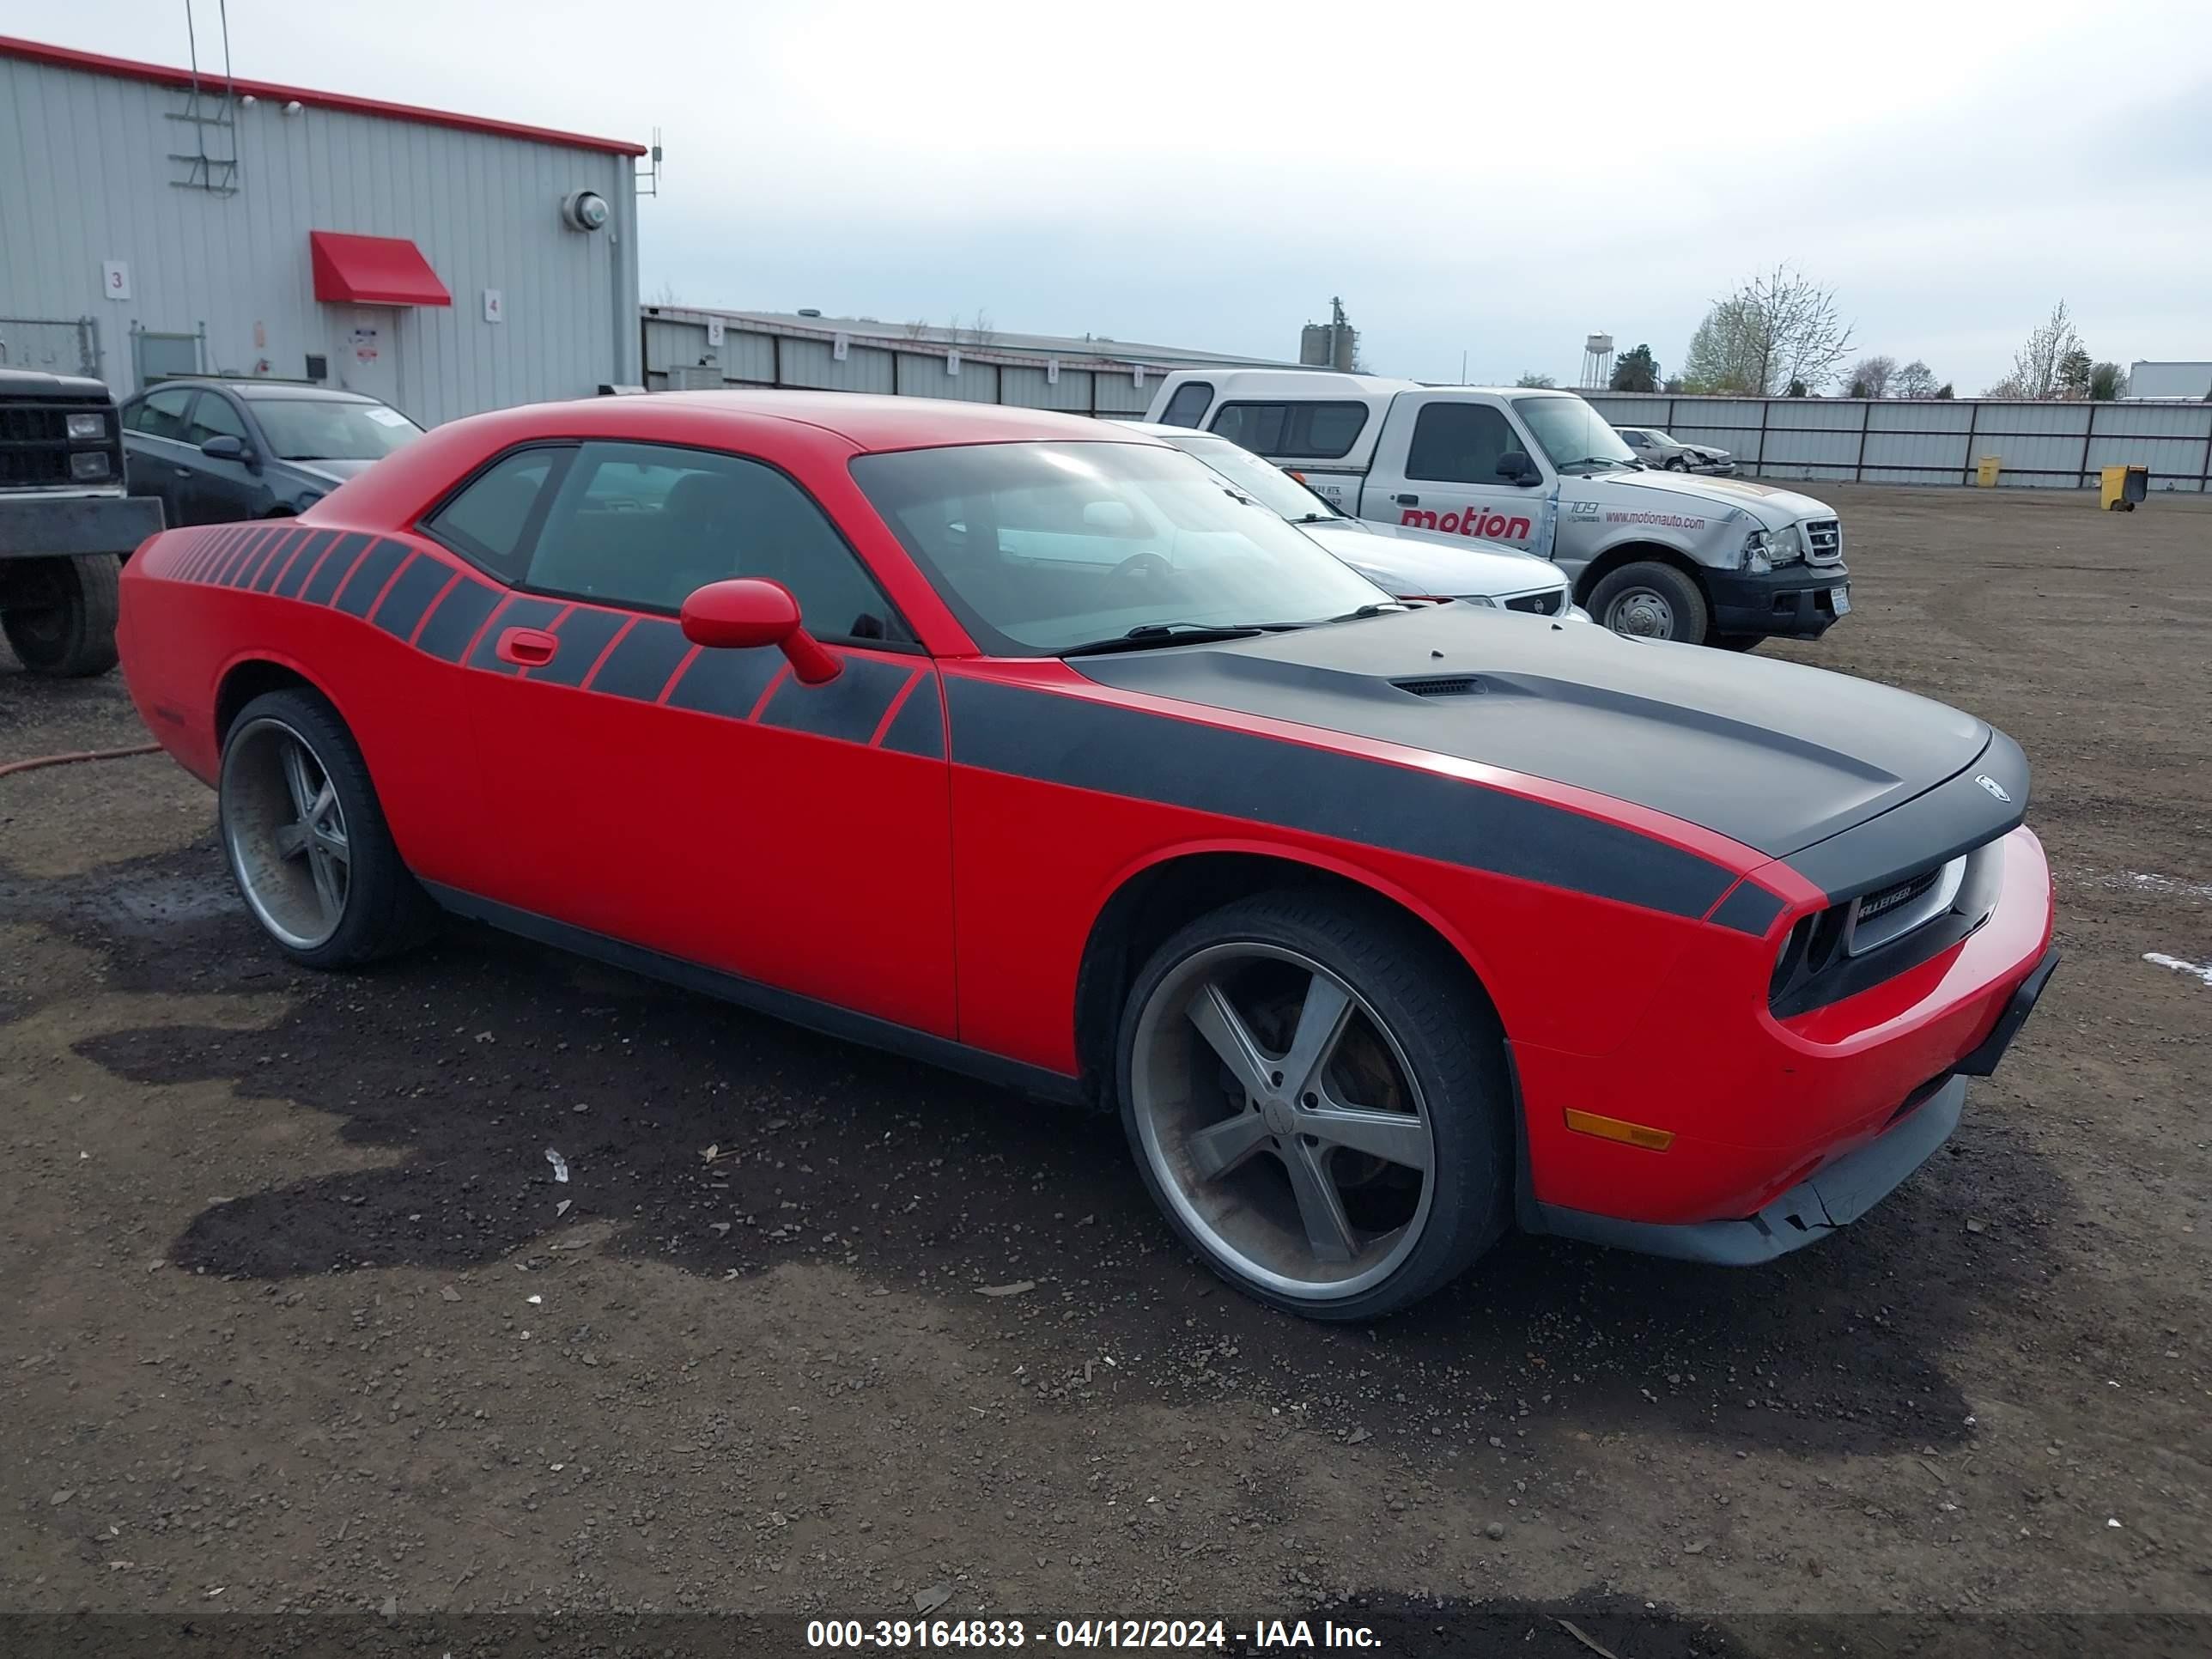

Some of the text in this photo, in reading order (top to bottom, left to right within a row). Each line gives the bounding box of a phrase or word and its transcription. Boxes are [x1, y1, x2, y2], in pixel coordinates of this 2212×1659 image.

[112, 271, 123, 289] 3
[1571, 501, 1600, 514] 109
[1401, 506, 1531, 540] motion
[1605, 509, 1705, 530] www.motionauto.com
